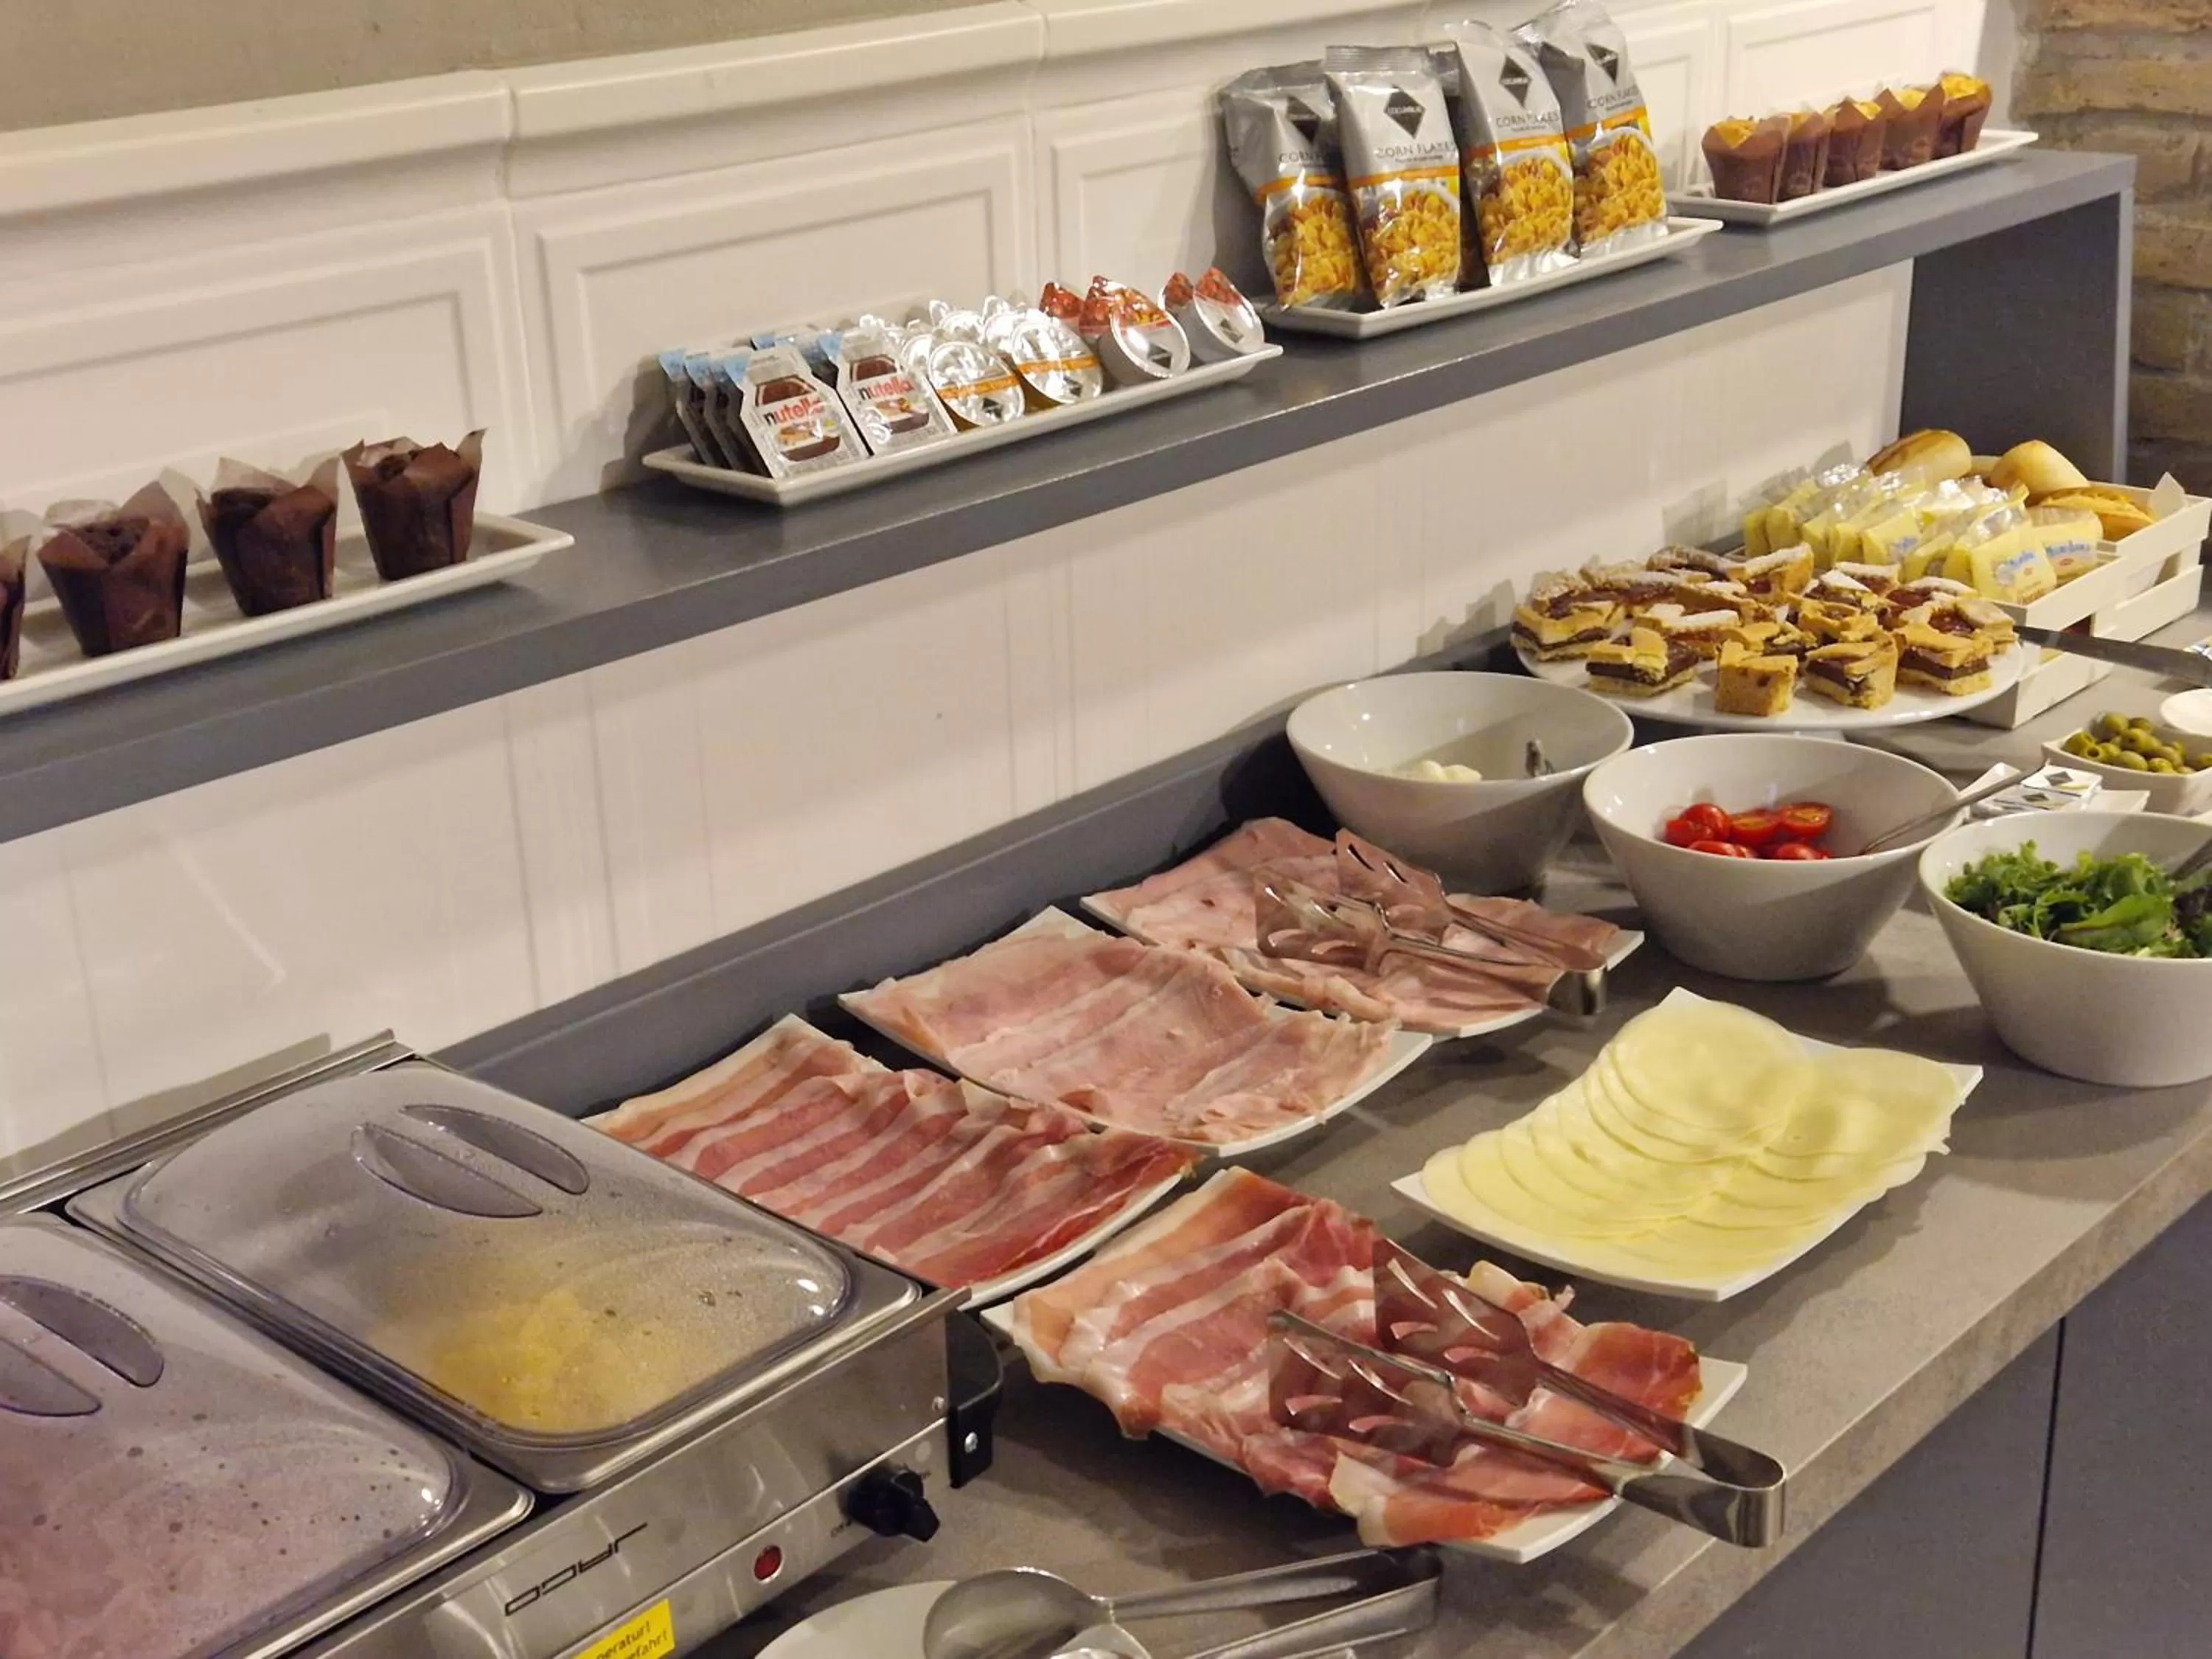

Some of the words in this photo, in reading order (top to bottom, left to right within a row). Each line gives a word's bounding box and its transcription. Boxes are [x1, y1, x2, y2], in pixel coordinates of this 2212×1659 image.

[1496, 114, 1527, 128] CORN
[1374, 144, 1414, 159] CORN
[858, 375, 915, 400] nutella
[763, 396, 825, 425] nutella
